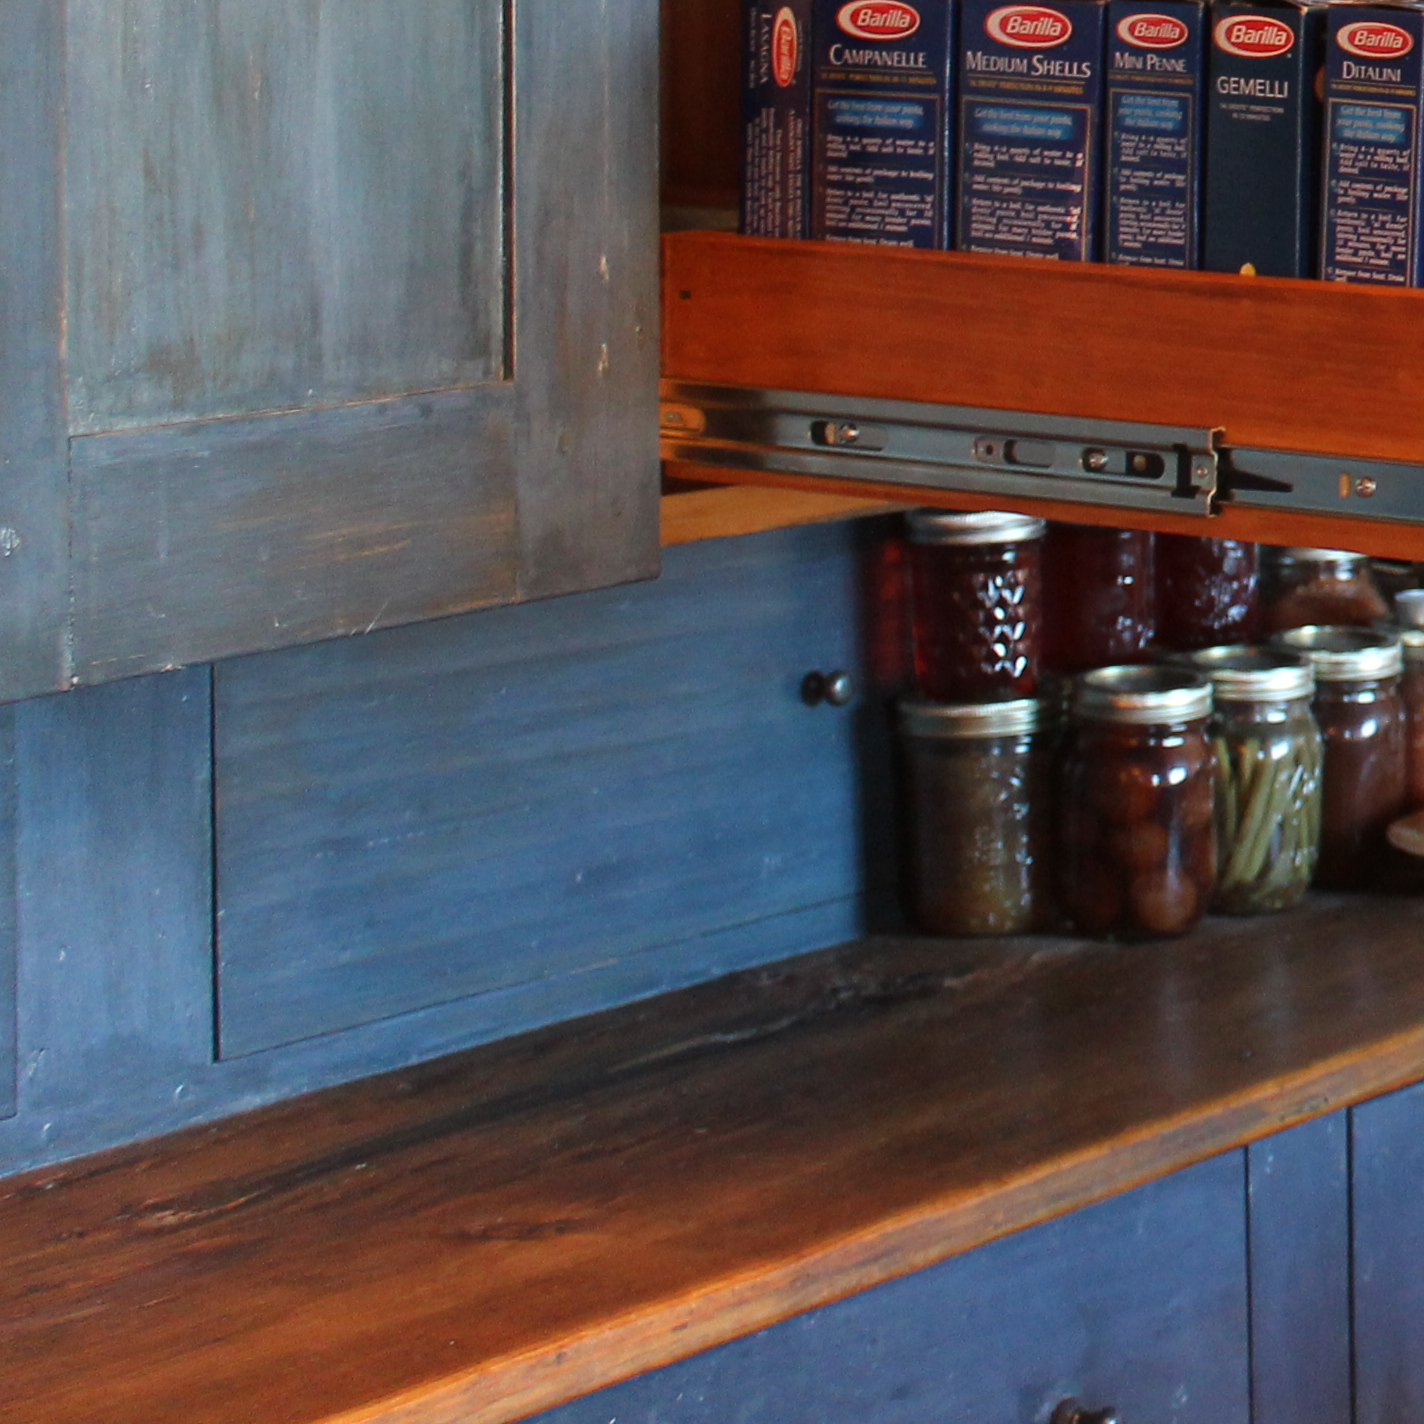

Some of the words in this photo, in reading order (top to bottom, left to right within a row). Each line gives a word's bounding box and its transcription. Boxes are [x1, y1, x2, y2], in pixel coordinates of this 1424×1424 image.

[857, 9, 910, 27] Barilla
[1006, 16, 1062, 36] Barilla
[1134, 22, 1179, 39] Barilla
[1231, 26, 1286, 46] Barilla
[1354, 31, 1403, 48] Barilla
[829, 44, 927, 68] CAMPANELLE
[966, 51, 1028, 73] MEDIUM
[1031, 54, 1091, 78] SHELLS
[1146, 55, 1188, 73] PENNE
[1342, 61, 1401, 82] DITALINI
[1217, 76, 1288, 98] GEMELLI
